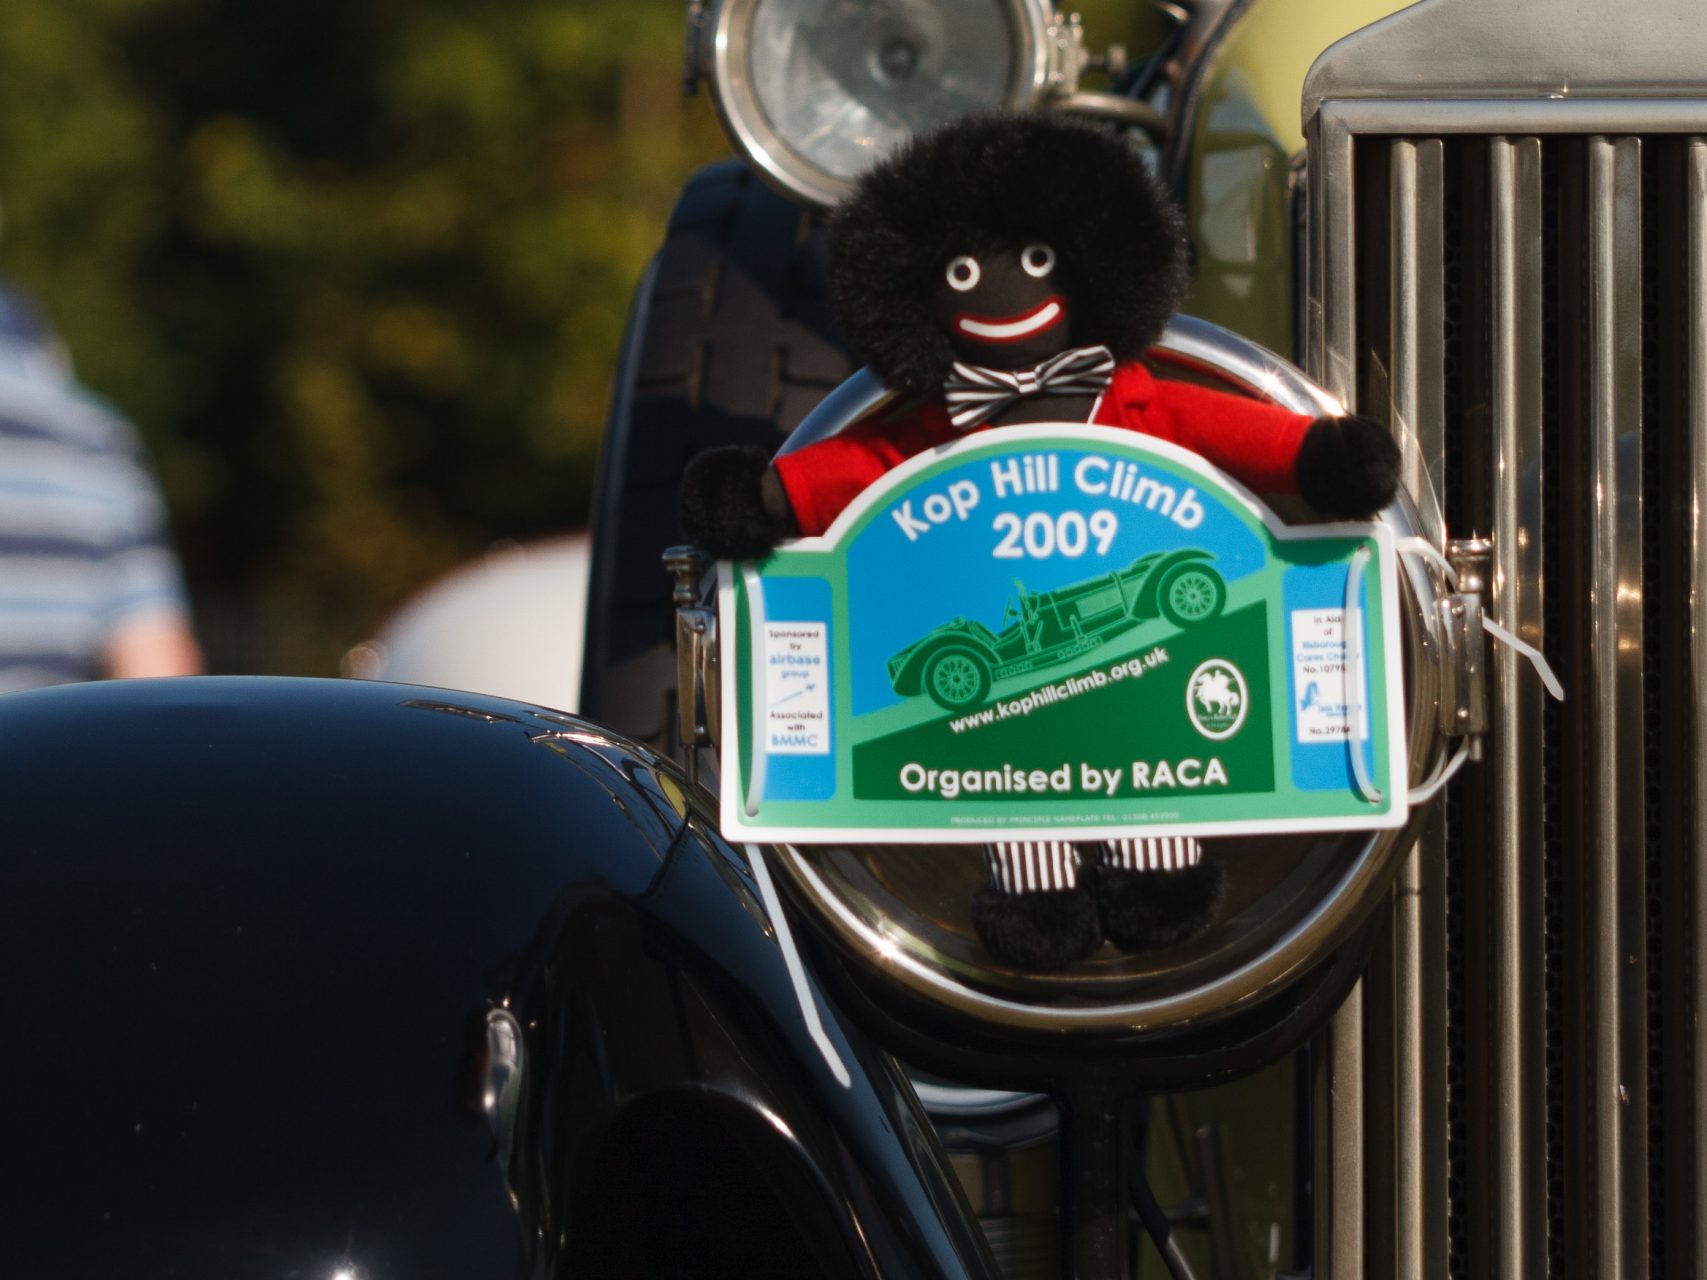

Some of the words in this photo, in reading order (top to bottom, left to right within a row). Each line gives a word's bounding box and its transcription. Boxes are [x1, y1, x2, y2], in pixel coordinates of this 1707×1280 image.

[891, 479, 980, 542] Kop
[990, 454, 1059, 499] Hill
[1074, 455, 1205, 529] Climb
[991, 509, 1119, 559] 2009
[769, 629, 819, 640] Sponsored
[769, 654, 821, 666] airbase
[950, 646, 1170, 734] www.kophillclimb.org.uk
[769, 711, 823, 721] Associated
[771, 734, 818, 747] BMMC
[899, 762, 1072, 799] Organised
[1080, 763, 1123, 796] by
[1132, 757, 1228, 789] RACA
